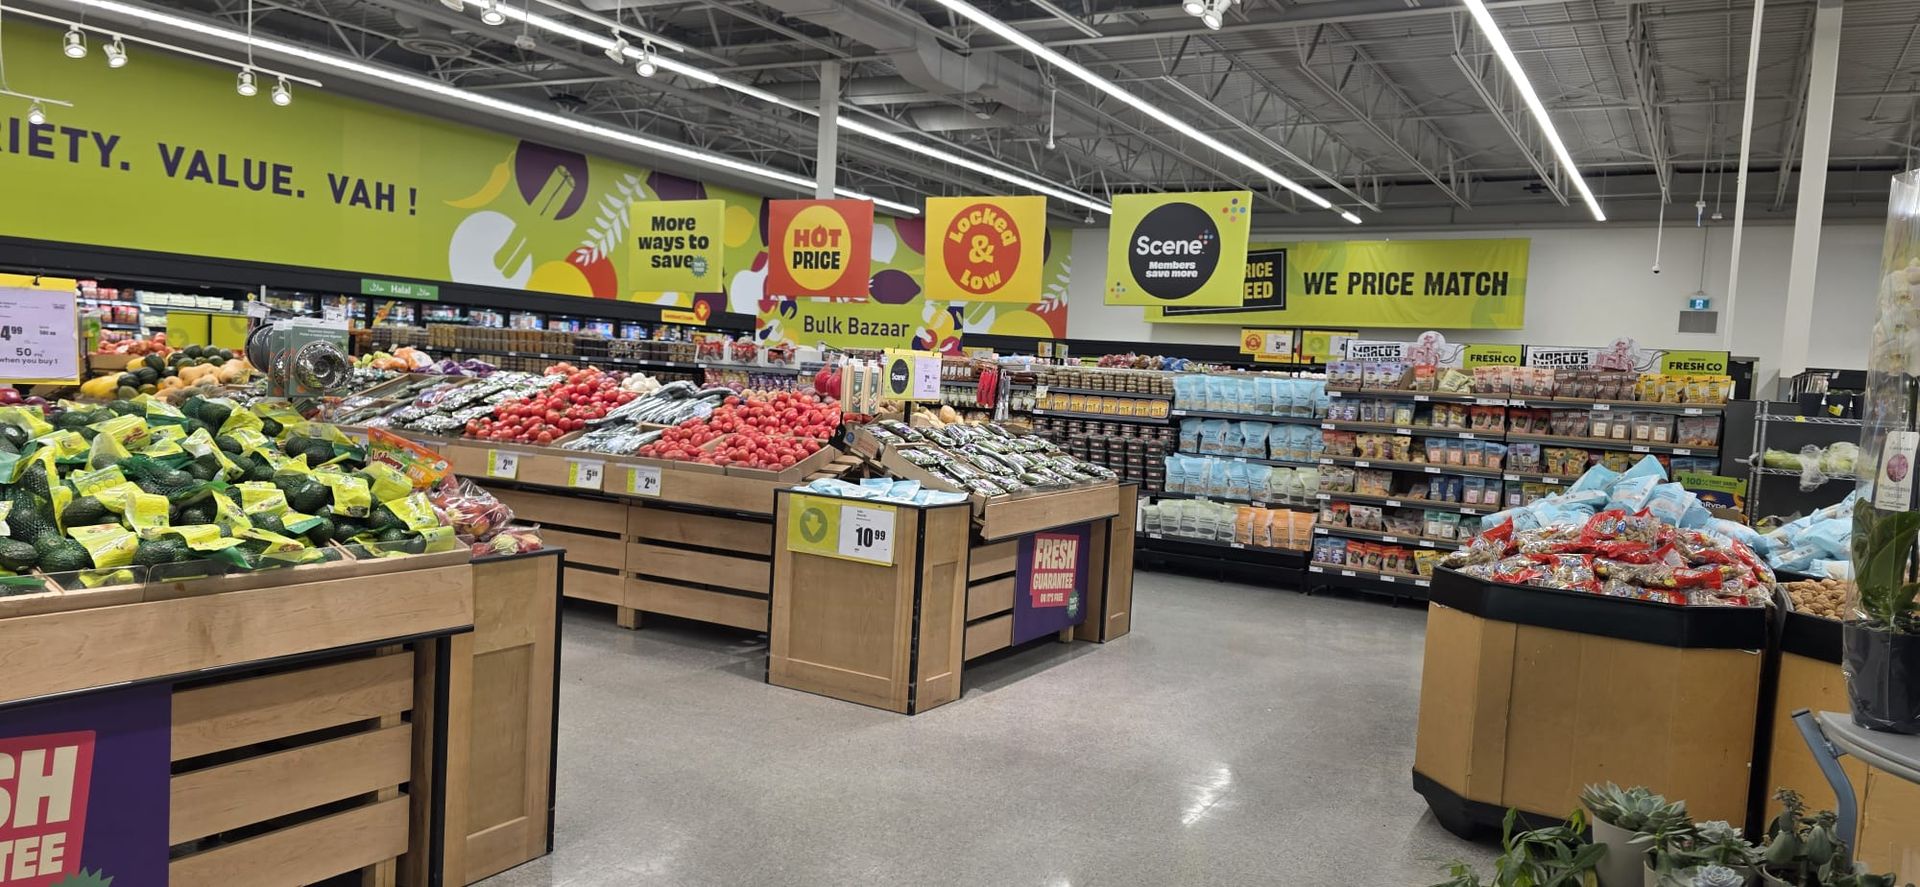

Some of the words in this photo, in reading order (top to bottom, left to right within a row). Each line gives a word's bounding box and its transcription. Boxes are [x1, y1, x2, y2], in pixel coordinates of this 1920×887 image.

[0, 117, 130, 171] IETY.
[158, 142, 305, 198] VALUE.
[328, 172, 395, 213] VAH
[651, 216, 696, 231] More
[638, 236, 685, 252] ways
[689, 234, 709, 249] to
[794, 225, 842, 248] HOT
[1136, 235, 1203, 255] Scene
[969, 234, 994, 263] &
[651, 255, 694, 268] save
[793, 251, 840, 269] PRICE
[1149, 261, 1196, 269] Members
[1145, 270, 1170, 278] save
[1171, 270, 1198, 278] more
[1246, 261, 1273, 278] RICE
[391, 284, 411, 295] Halal
[1244, 281, 1273, 299] EED
[1303, 271, 1338, 295] WE
[1347, 271, 1415, 296] PRICE
[1424, 271, 1509, 296] MATCH
[804, 315, 843, 334] Bulk
[848, 317, 910, 337] Bazaar
[16, 347, 32, 356] 50
[1353, 345, 1400, 357] MARCO'S
[1470, 354, 1501, 362] FRESH
[1502, 355, 1517, 363] CO
[1533, 352, 1588, 365] MARCO'S
[38, 358, 53, 366] buy
[1669, 361, 1704, 370] FRESH
[1706, 363, 1722, 371] CO
[1034, 538, 1077, 569] FRESH
[1033, 572, 1074, 590] GUARANTEE
[0, 832, 67, 883] TEE
